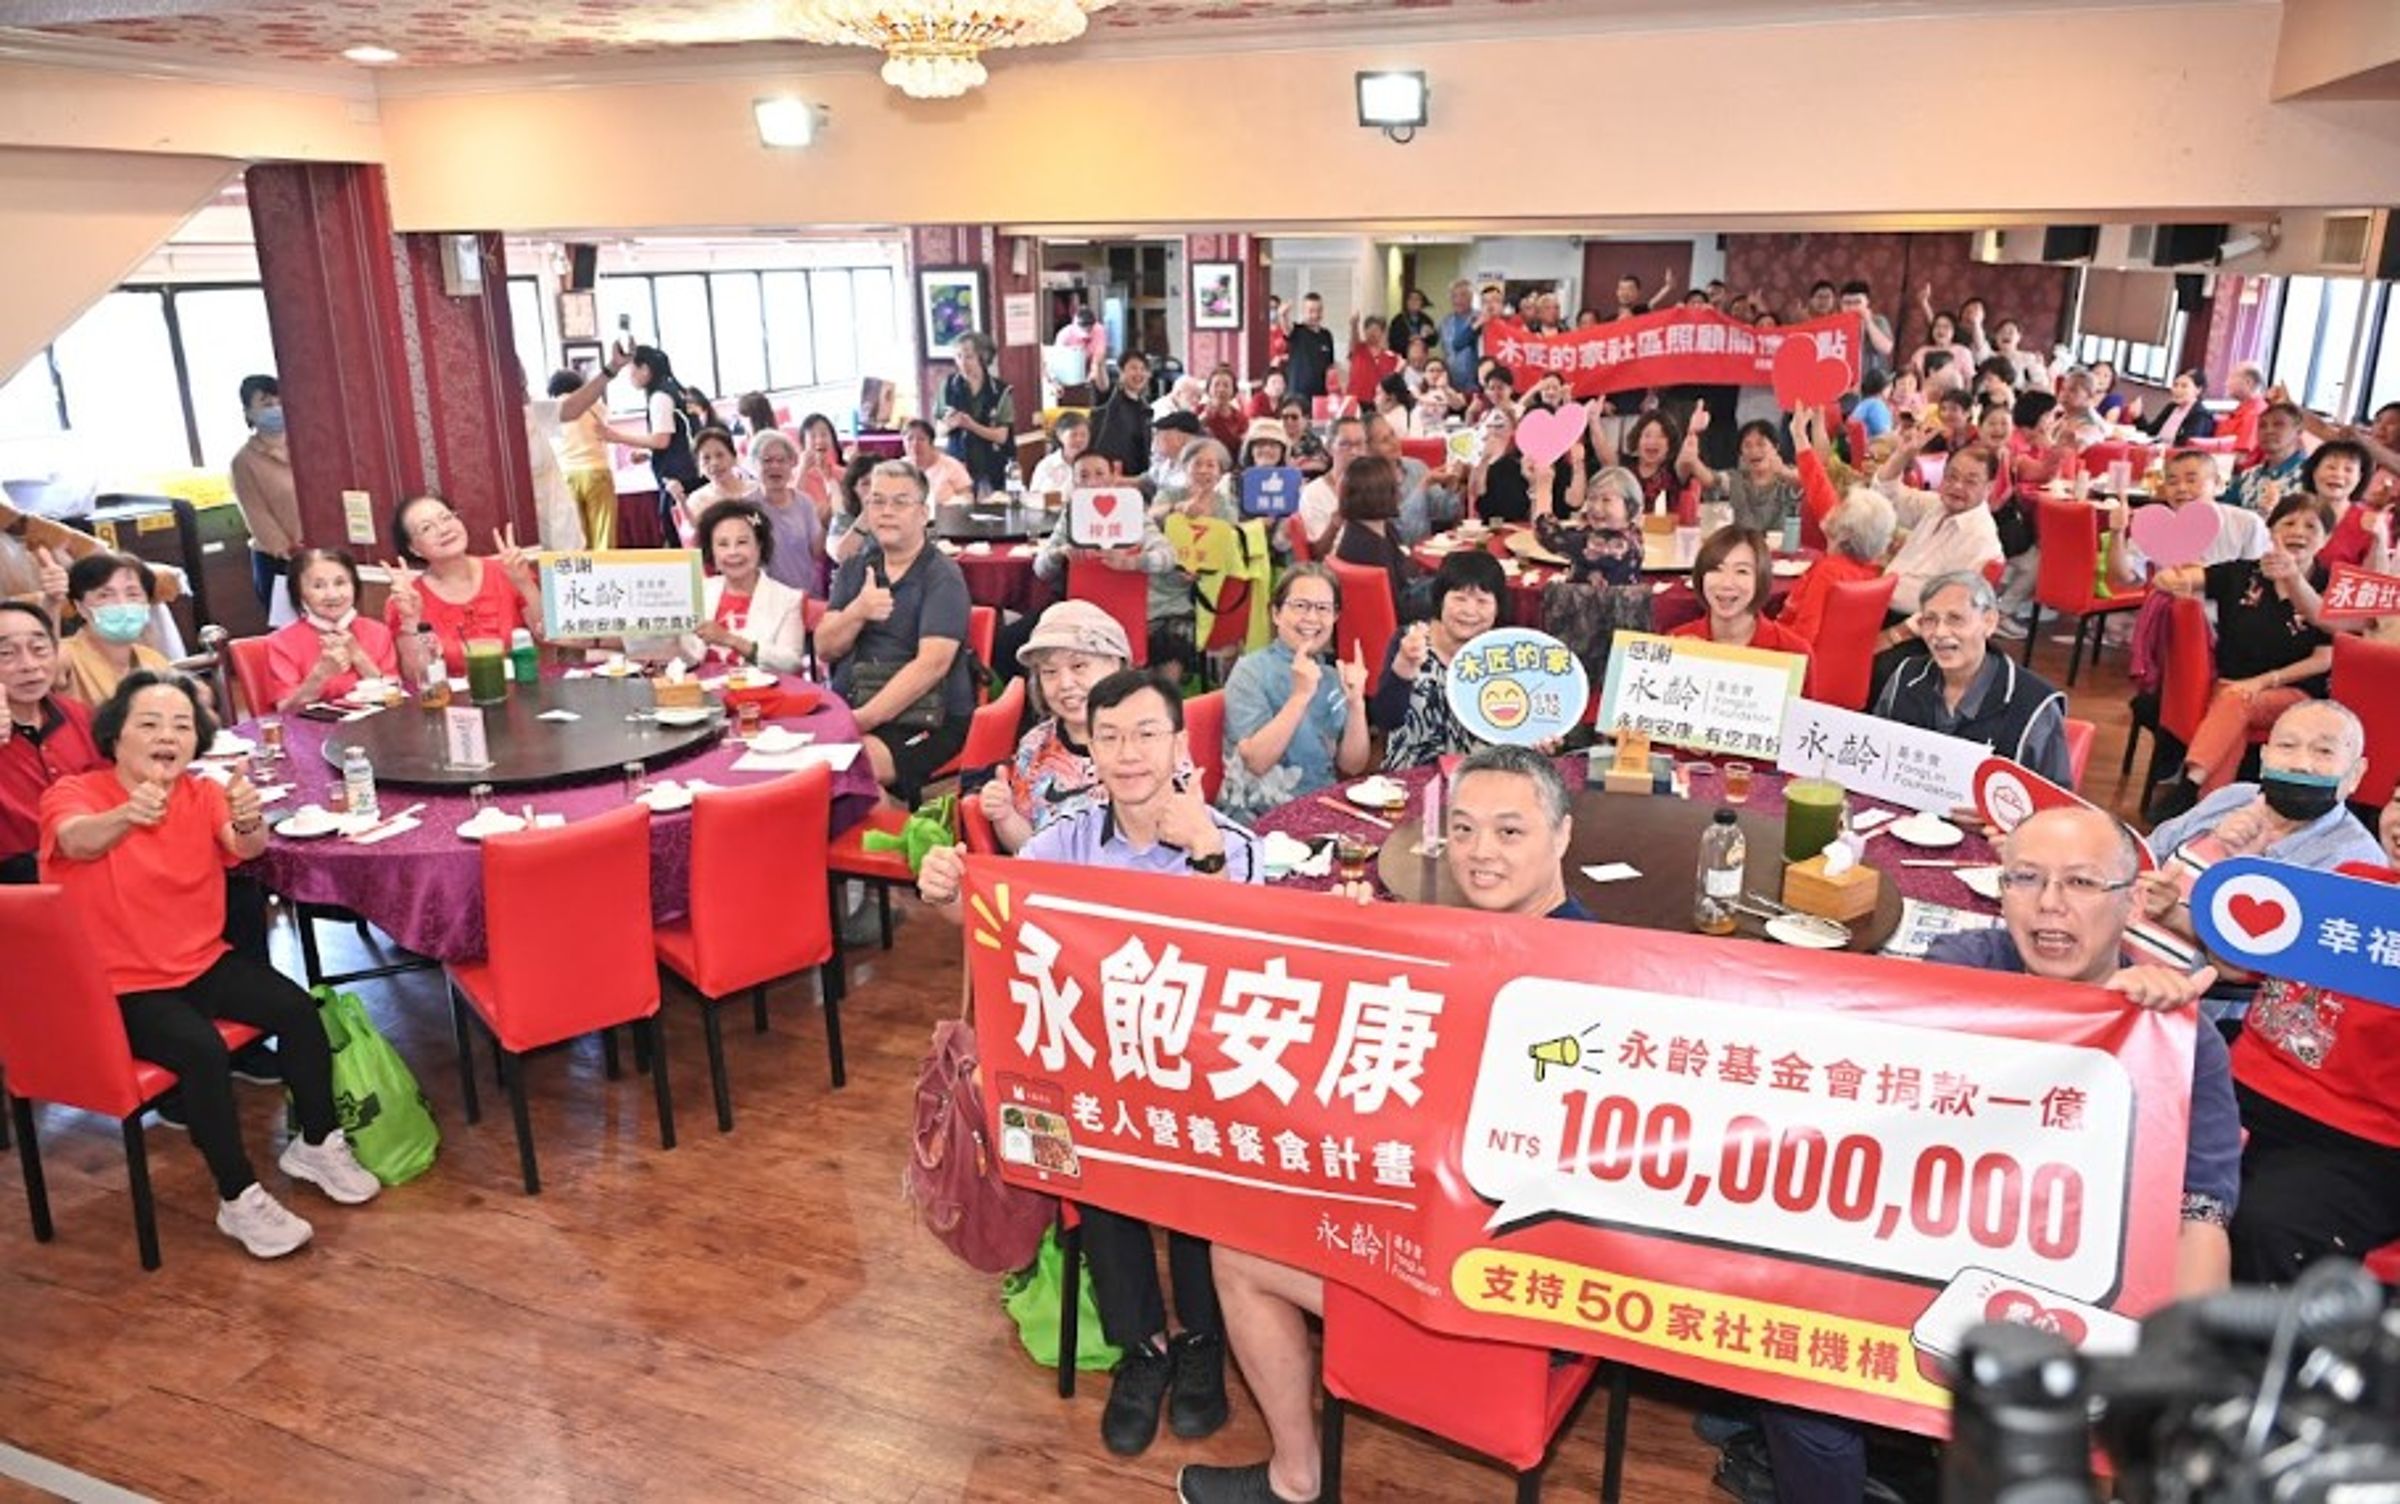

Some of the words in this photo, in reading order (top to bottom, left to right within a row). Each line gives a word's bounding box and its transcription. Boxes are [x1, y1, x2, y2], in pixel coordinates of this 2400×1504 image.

[1455, 641, 1573, 683] 木匠的家
[1628, 641, 1672, 664] 感謝
[1627, 668, 1700, 711] 永齡
[1797, 721, 1880, 774] 永齡
[2318, 916, 2400, 968] 幸福
[1008, 919, 1445, 1114] 永飽安康
[1618, 1029, 2087, 1131] 永齡基金會捐款一億
[1071, 1091, 1417, 1189] 老人營養餐食計畫
[1488, 1128, 1542, 1159] NT$
[1557, 1089, 2084, 1261] 100,000,000
[1316, 1211, 1384, 1265] 永齡
